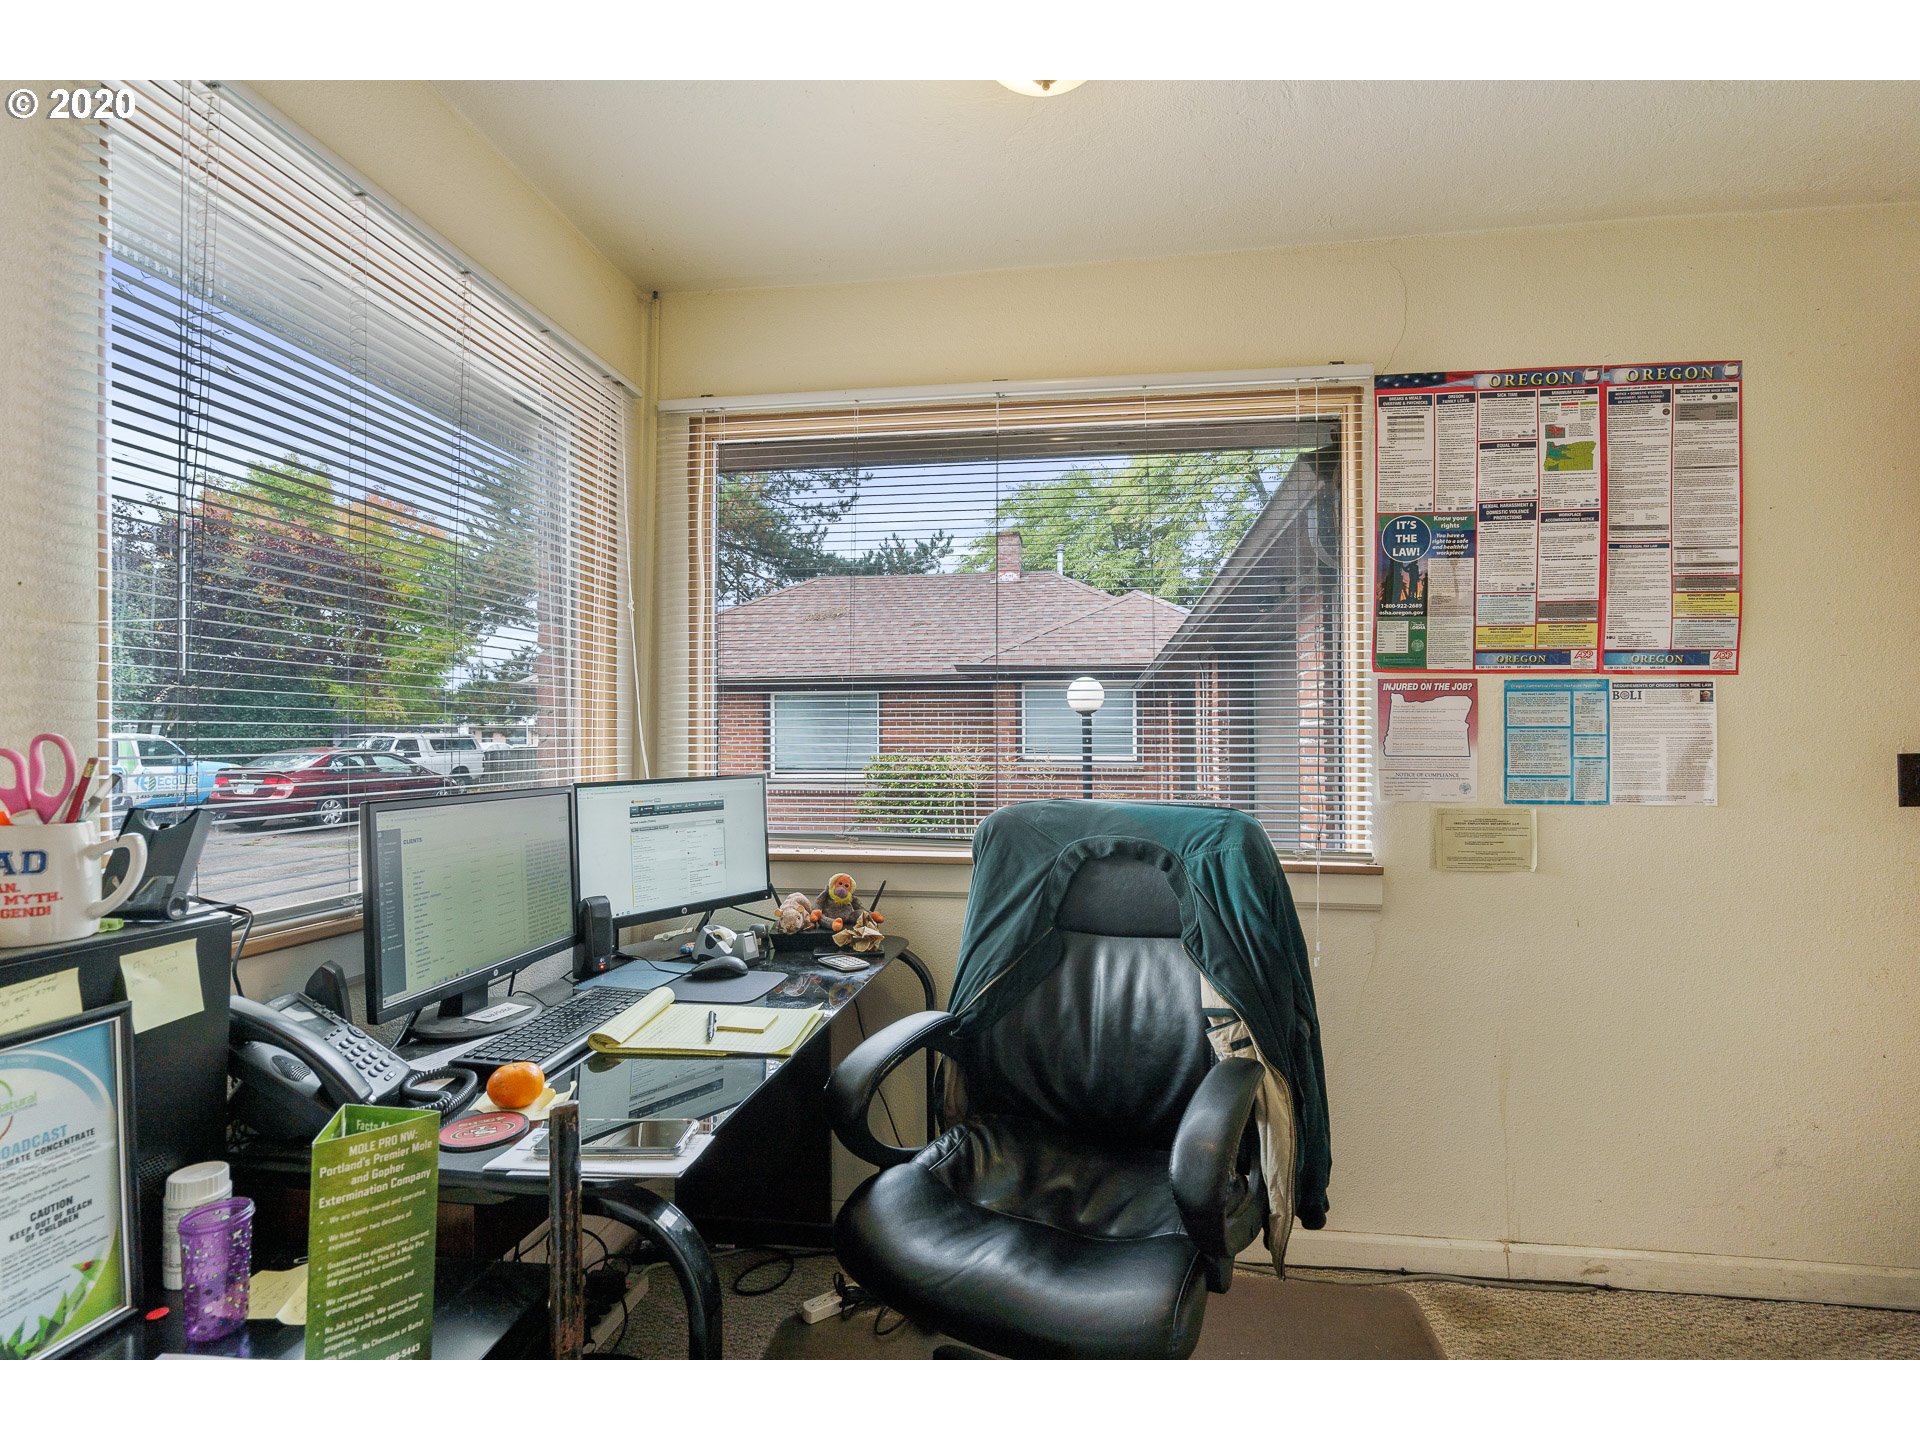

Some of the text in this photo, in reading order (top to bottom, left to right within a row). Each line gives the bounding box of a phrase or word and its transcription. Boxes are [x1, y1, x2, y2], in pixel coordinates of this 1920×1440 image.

[1489, 371, 1575, 387] OREGON
[1625, 366, 1715, 382] OREGON
[1396, 520, 1417, 530] IT'S
[1396, 534, 1418, 543] THE
[1392, 548, 1420, 557] LAW!
[1496, 655, 1546, 664] OREGON
[1632, 654, 1684, 664] OREGON
[1452, 683, 1473, 691] JOB?
[403, 837, 422, 845] CLIENTS
[4, 892, 64, 906] MYTH.
[0, 906, 51, 919] GEND!
[356, 1120, 390, 1131] Facts A
[34, 1128, 96, 1157] CONCENTRATE
[348, 1129, 418, 1157] MOLE PRO NW:
[319, 1139, 433, 1178] Portland's Premier Mole
[351, 1163, 405, 1185] and Gopher
[319, 1168, 432, 1209] Extermination Company
[30, 1196, 74, 1222] CAUTION
[329, 1188, 427, 1224] We are family-owned and operated.
[9, 1198, 93, 1242] KEEP OUT OF REACH
[25, 1213, 79, 1243] OF CHILDREN
[328, 1210, 412, 1242] We have over two decades of
[327, 1252, 362, 1270] Guaranteed
[370, 1242, 396, 1256] eliminate
[397, 1238, 409, 1248] your
[328, 1237, 361, 1252] experience.
[326, 1266, 352, 1280] problem
[352, 1259, 375, 1272] entirely.
[377, 1254, 389, 1262] This
[401, 1244, 414, 1254] Mole
[415, 1240, 425, 1249] Pro
[327, 1280, 338, 1288] NW
[338, 1272, 362, 1286] promise
[382, 1254, 412, 1270] customers.
[326, 1299, 336, 1307] We
[337, 1291, 359, 1303] remove
[380, 1275, 403, 1289] gophers
[404, 1268, 414, 1279] and
[325, 1304, 347, 1317] ground
[334, 1322, 346, 1332] Job
[354, 1316, 364, 1324] too
[376, 1306, 386, 1315] We
[387, 1299, 408, 1311] service
[324, 1300, 419, 1344] commercial and large agricultural
[371, 1330, 400, 1346] Chemicals
